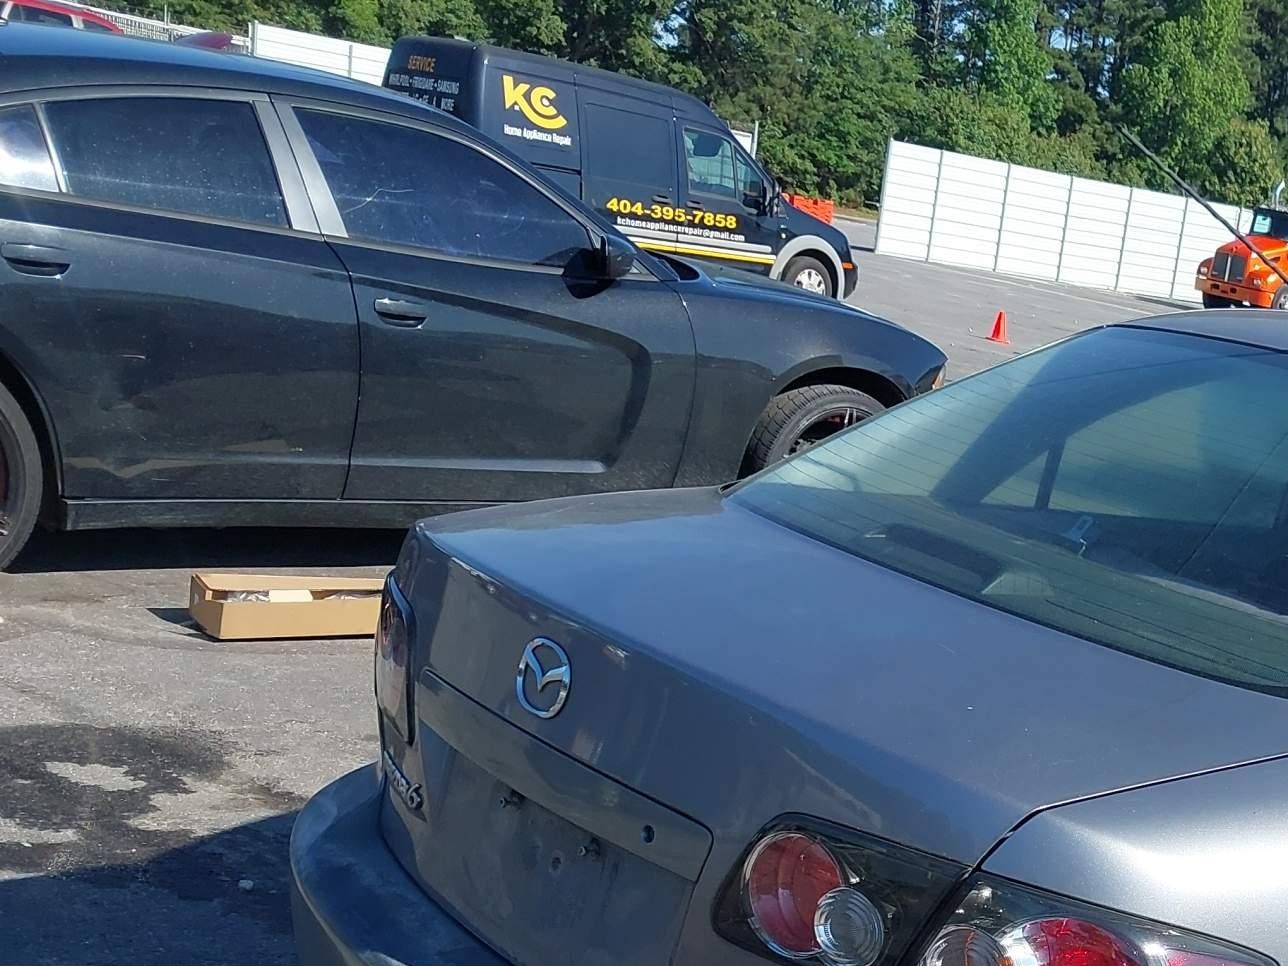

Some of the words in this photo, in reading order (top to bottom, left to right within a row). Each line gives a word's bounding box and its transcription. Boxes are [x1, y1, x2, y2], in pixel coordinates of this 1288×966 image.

[408, 55, 436, 73] SERVICE
[502, 74, 568, 129] KC
[503, 124, 522, 137] Home
[523, 128, 552, 142] Appliance
[552, 133, 572, 146] Repair
[606, 197, 737, 229] 404-395-7858
[616, 215, 746, 242] kchomeappliancerepair@gmail.com
